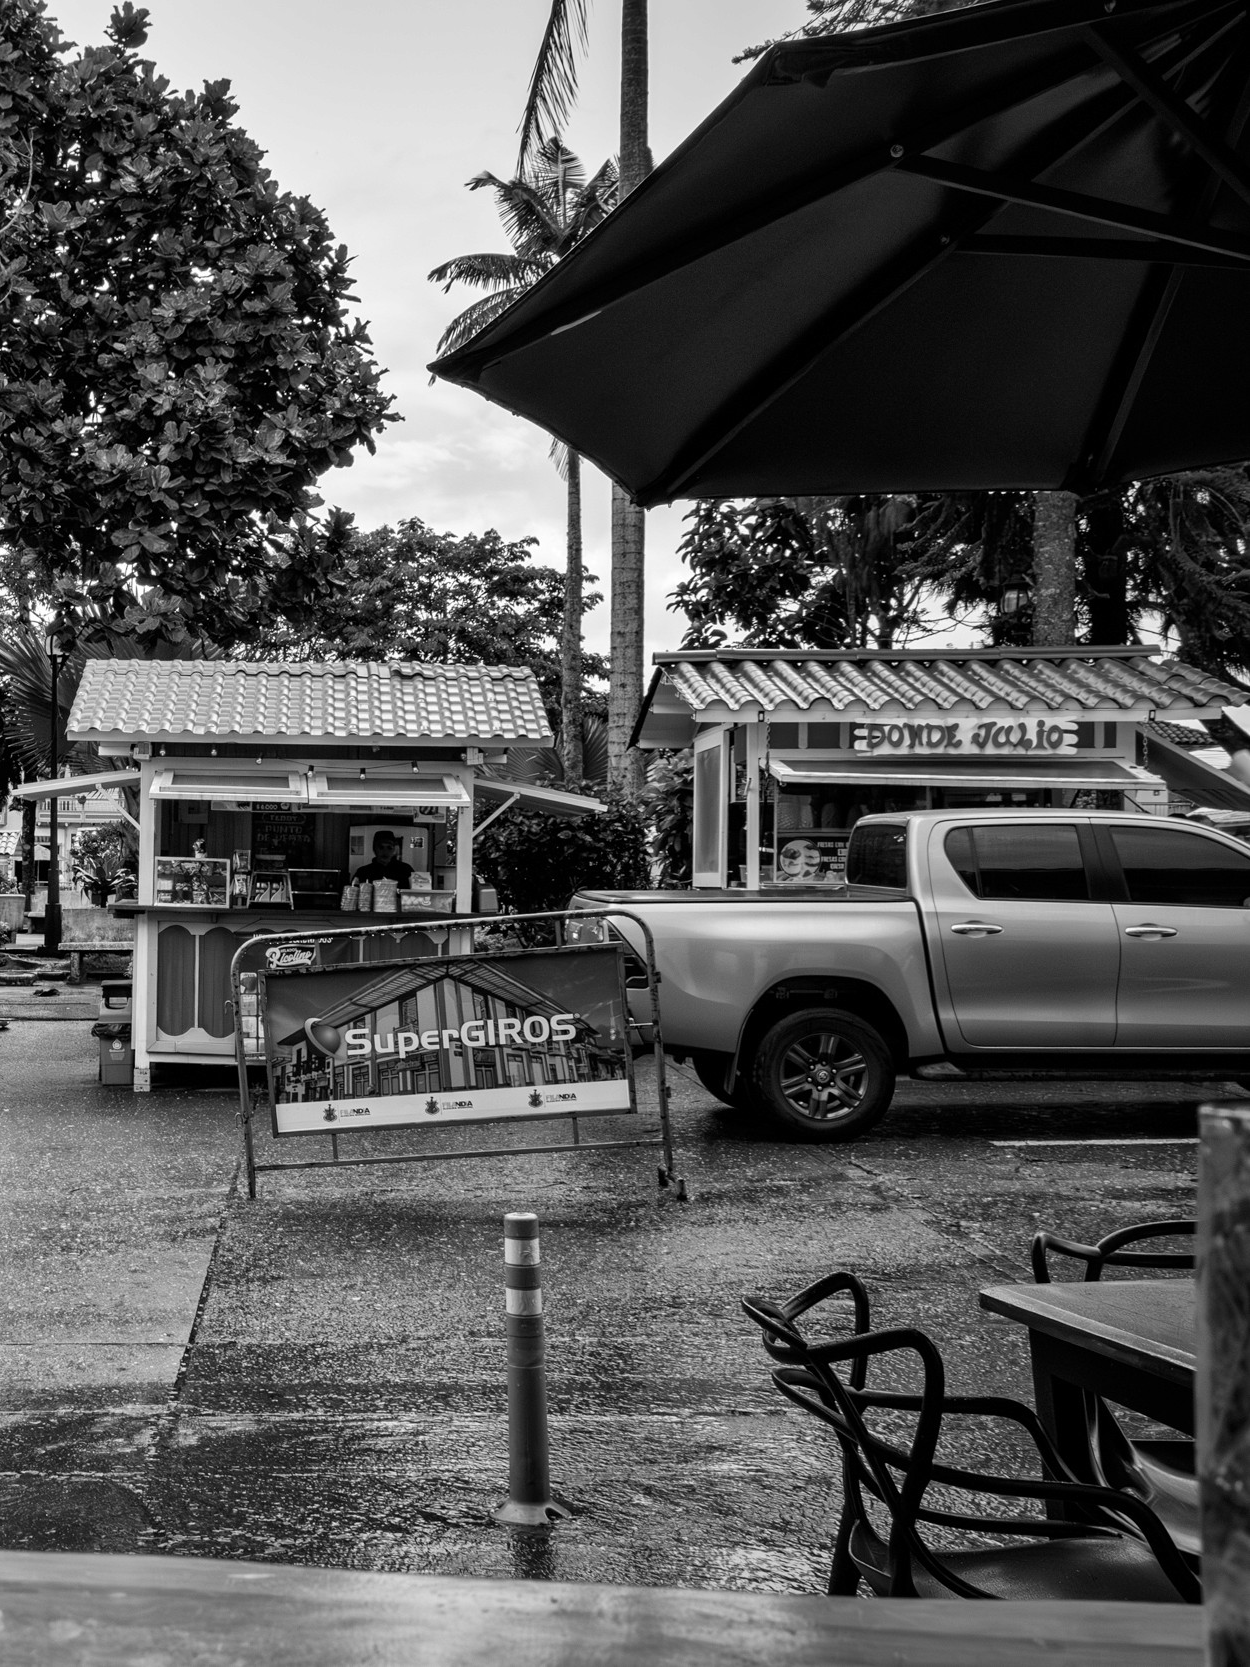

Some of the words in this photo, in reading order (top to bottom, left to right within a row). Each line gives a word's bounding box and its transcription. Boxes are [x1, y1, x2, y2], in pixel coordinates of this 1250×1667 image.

[864, 722, 963, 749] DONDE
[265, 825, 303, 834] PUNTO
[345, 1014, 577, 1058] SuperGIROS
